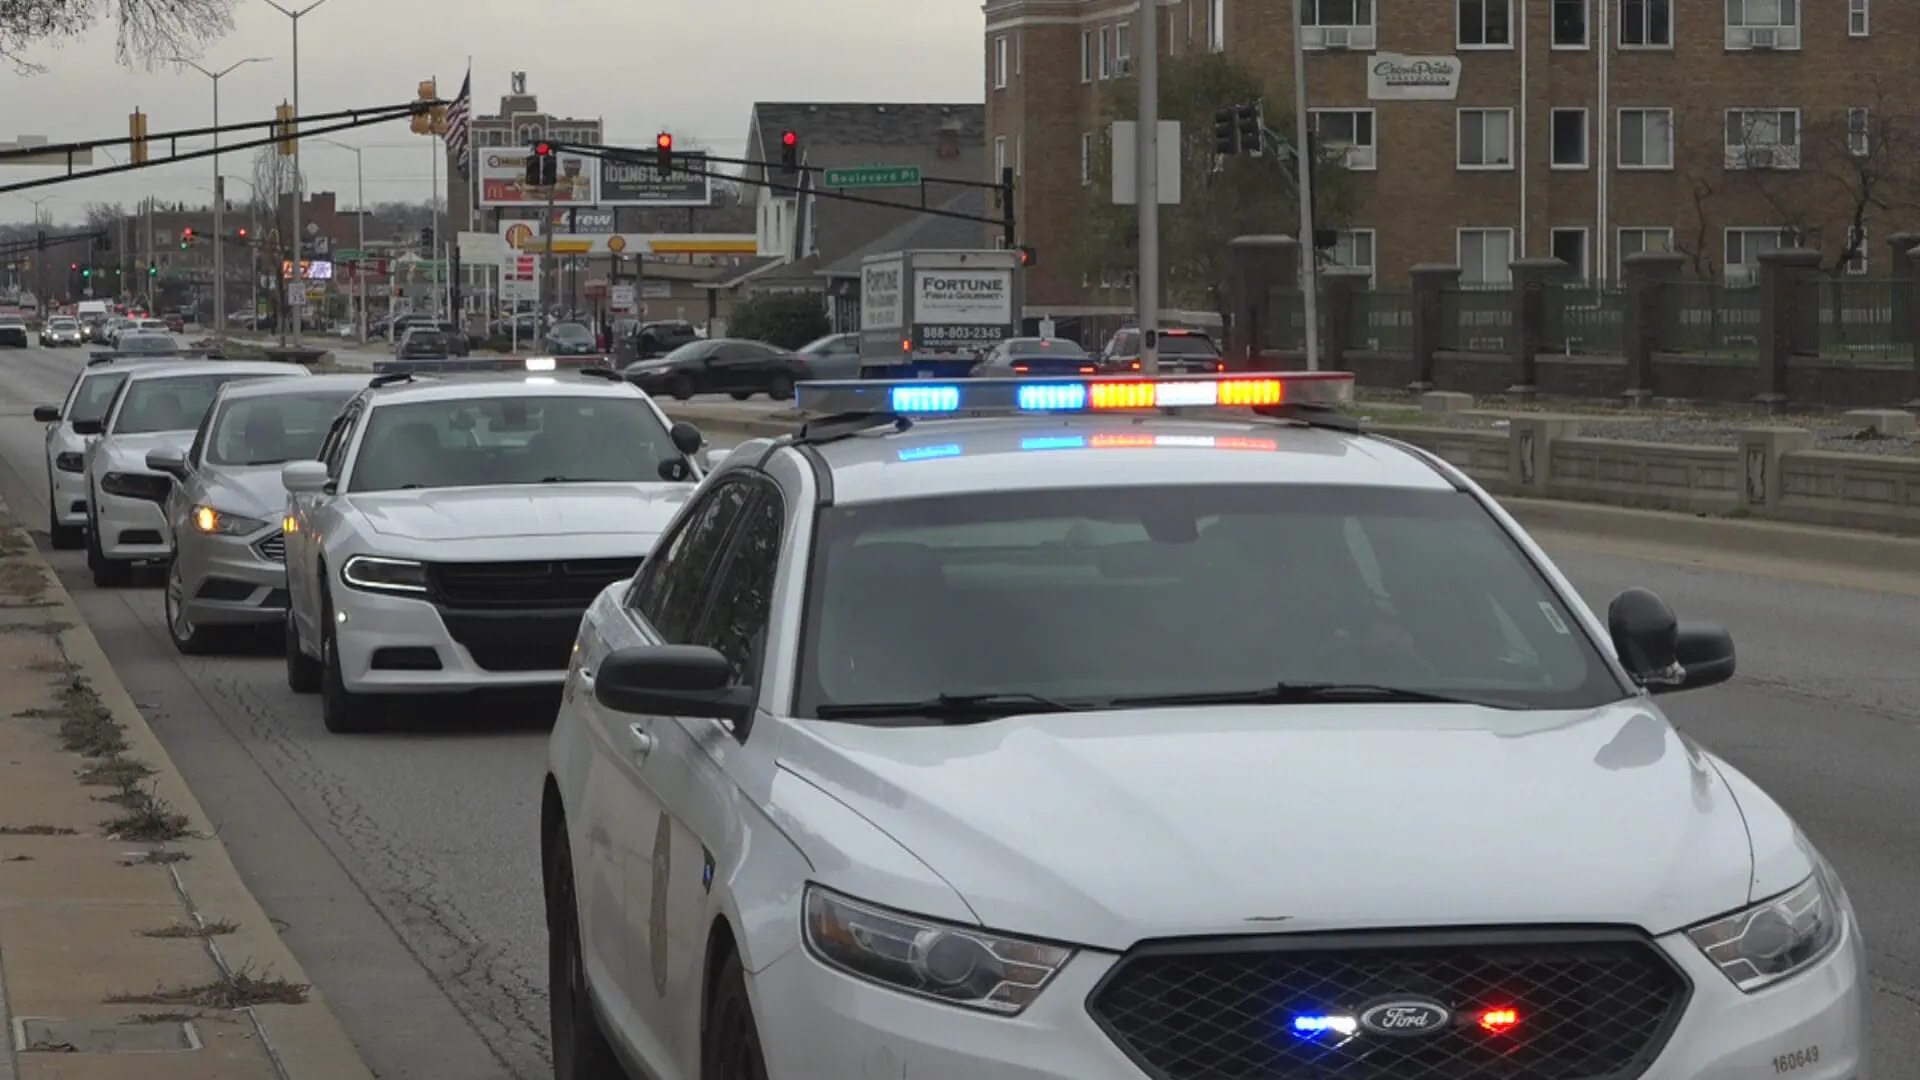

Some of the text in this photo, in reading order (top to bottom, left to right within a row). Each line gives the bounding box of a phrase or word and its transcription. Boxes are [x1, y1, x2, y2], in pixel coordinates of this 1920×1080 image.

[831, 170, 915, 184] Boulevard Pl
[923, 277, 1003, 290] FORTUNE
[923, 327, 1001, 339] 888-603-2345
[1382, 1007, 1429, 1028] Ford
[1772, 1045, 1819, 1073] 160649
